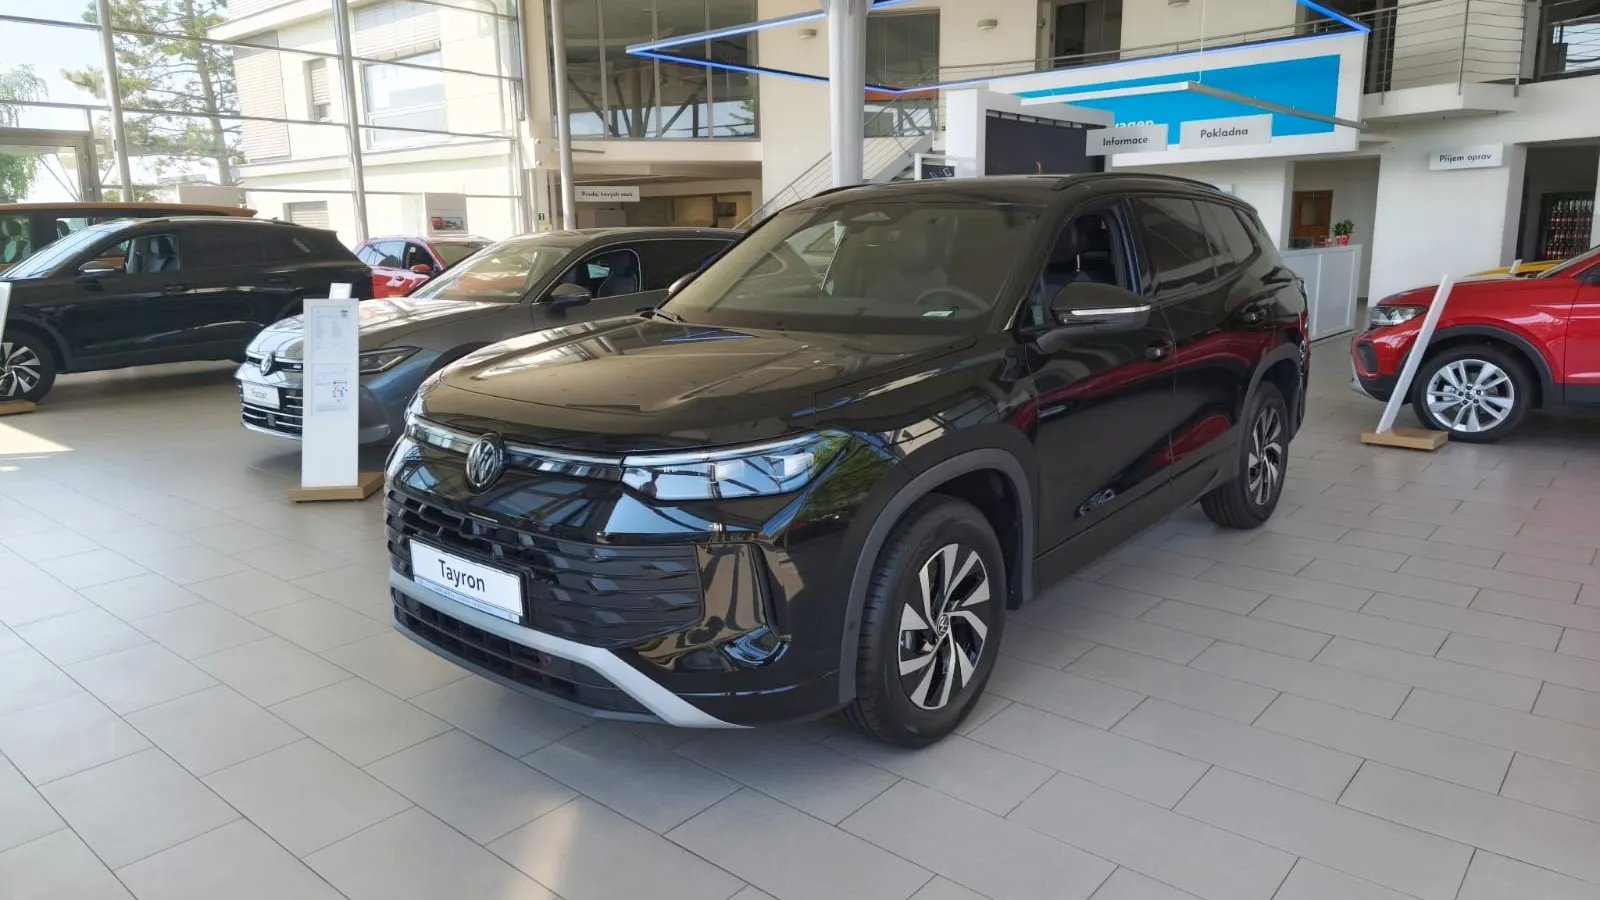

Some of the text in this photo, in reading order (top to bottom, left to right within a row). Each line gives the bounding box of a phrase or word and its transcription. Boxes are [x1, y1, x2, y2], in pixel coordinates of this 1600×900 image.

[1200, 127, 1248, 139] Pokladna
[1103, 136, 1148, 146] Informace
[1467, 153, 1493, 162] oprav
[438, 558, 485, 592] Tayron
